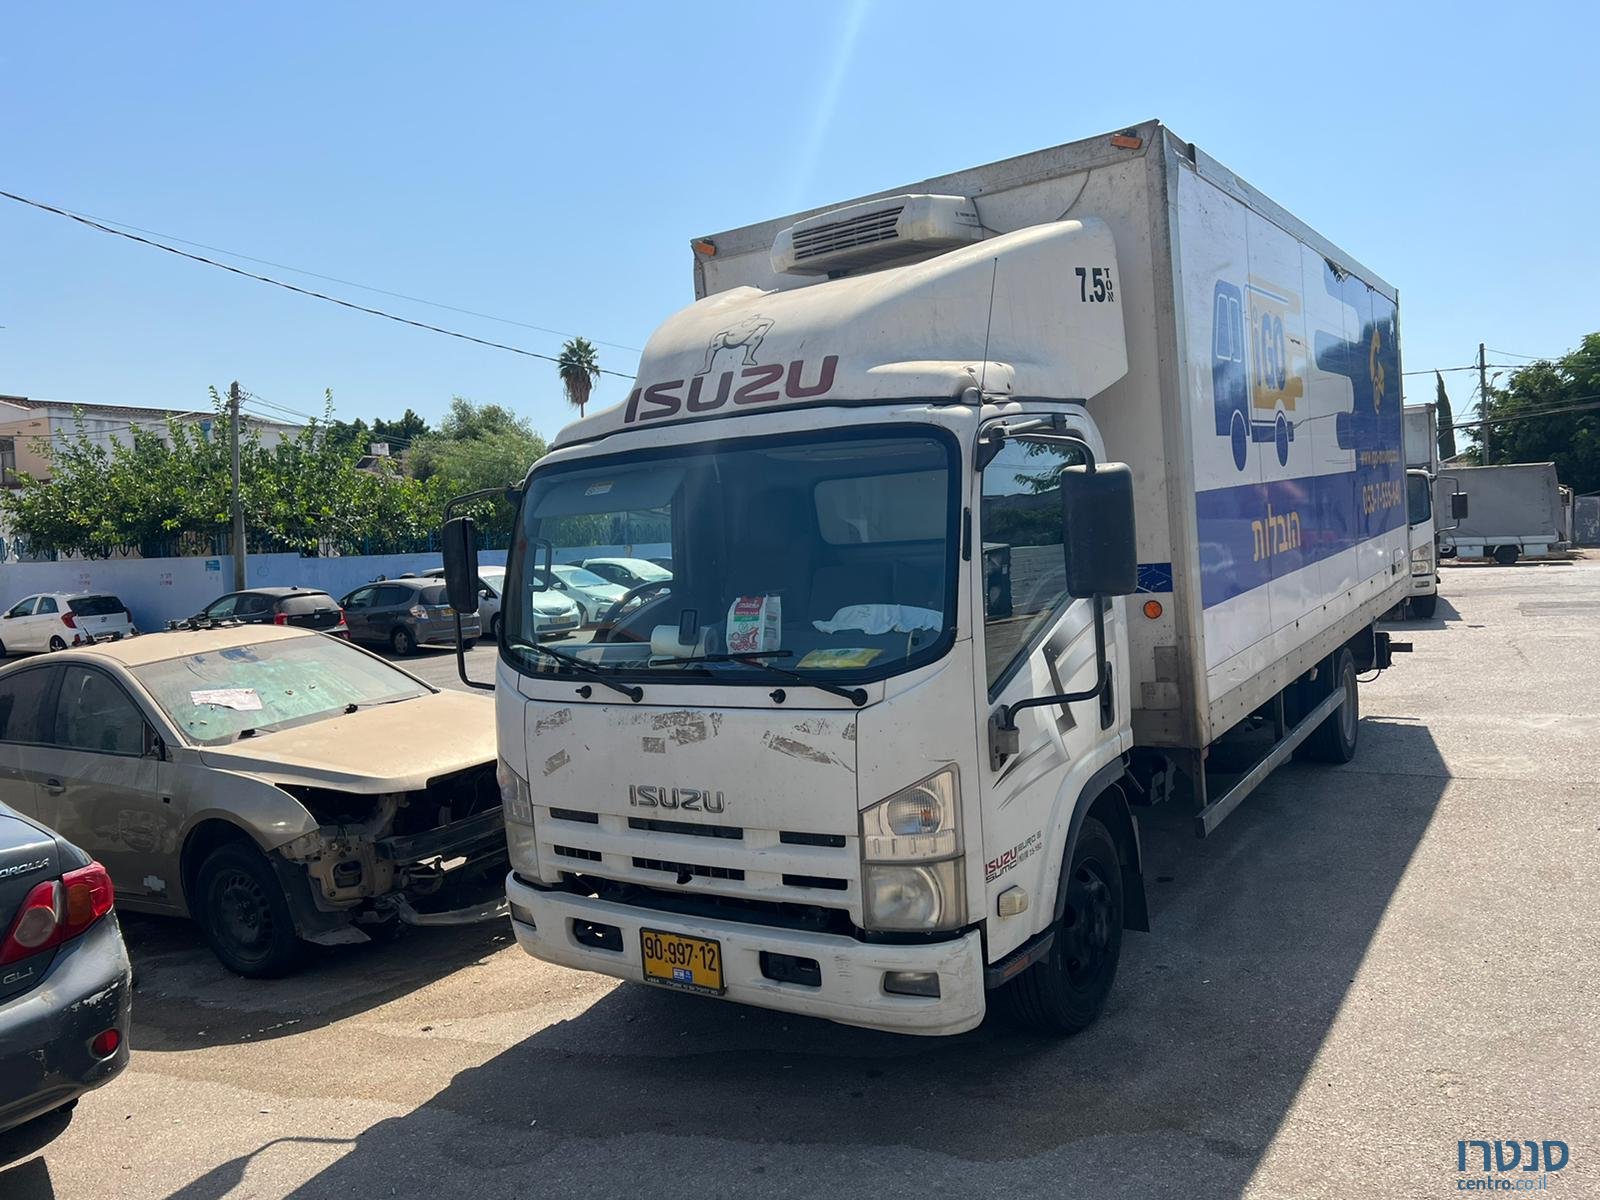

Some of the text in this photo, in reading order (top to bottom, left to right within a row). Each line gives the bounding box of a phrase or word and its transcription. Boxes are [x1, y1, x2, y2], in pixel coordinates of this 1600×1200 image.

[1075, 267, 1115, 303] 7.5 TON
[624, 355, 839, 424] ISUZU
[1251, 503, 1301, 562] הובלות
[629, 784, 725, 814] ISUZU
[985, 846, 1017, 875] ISUZU
